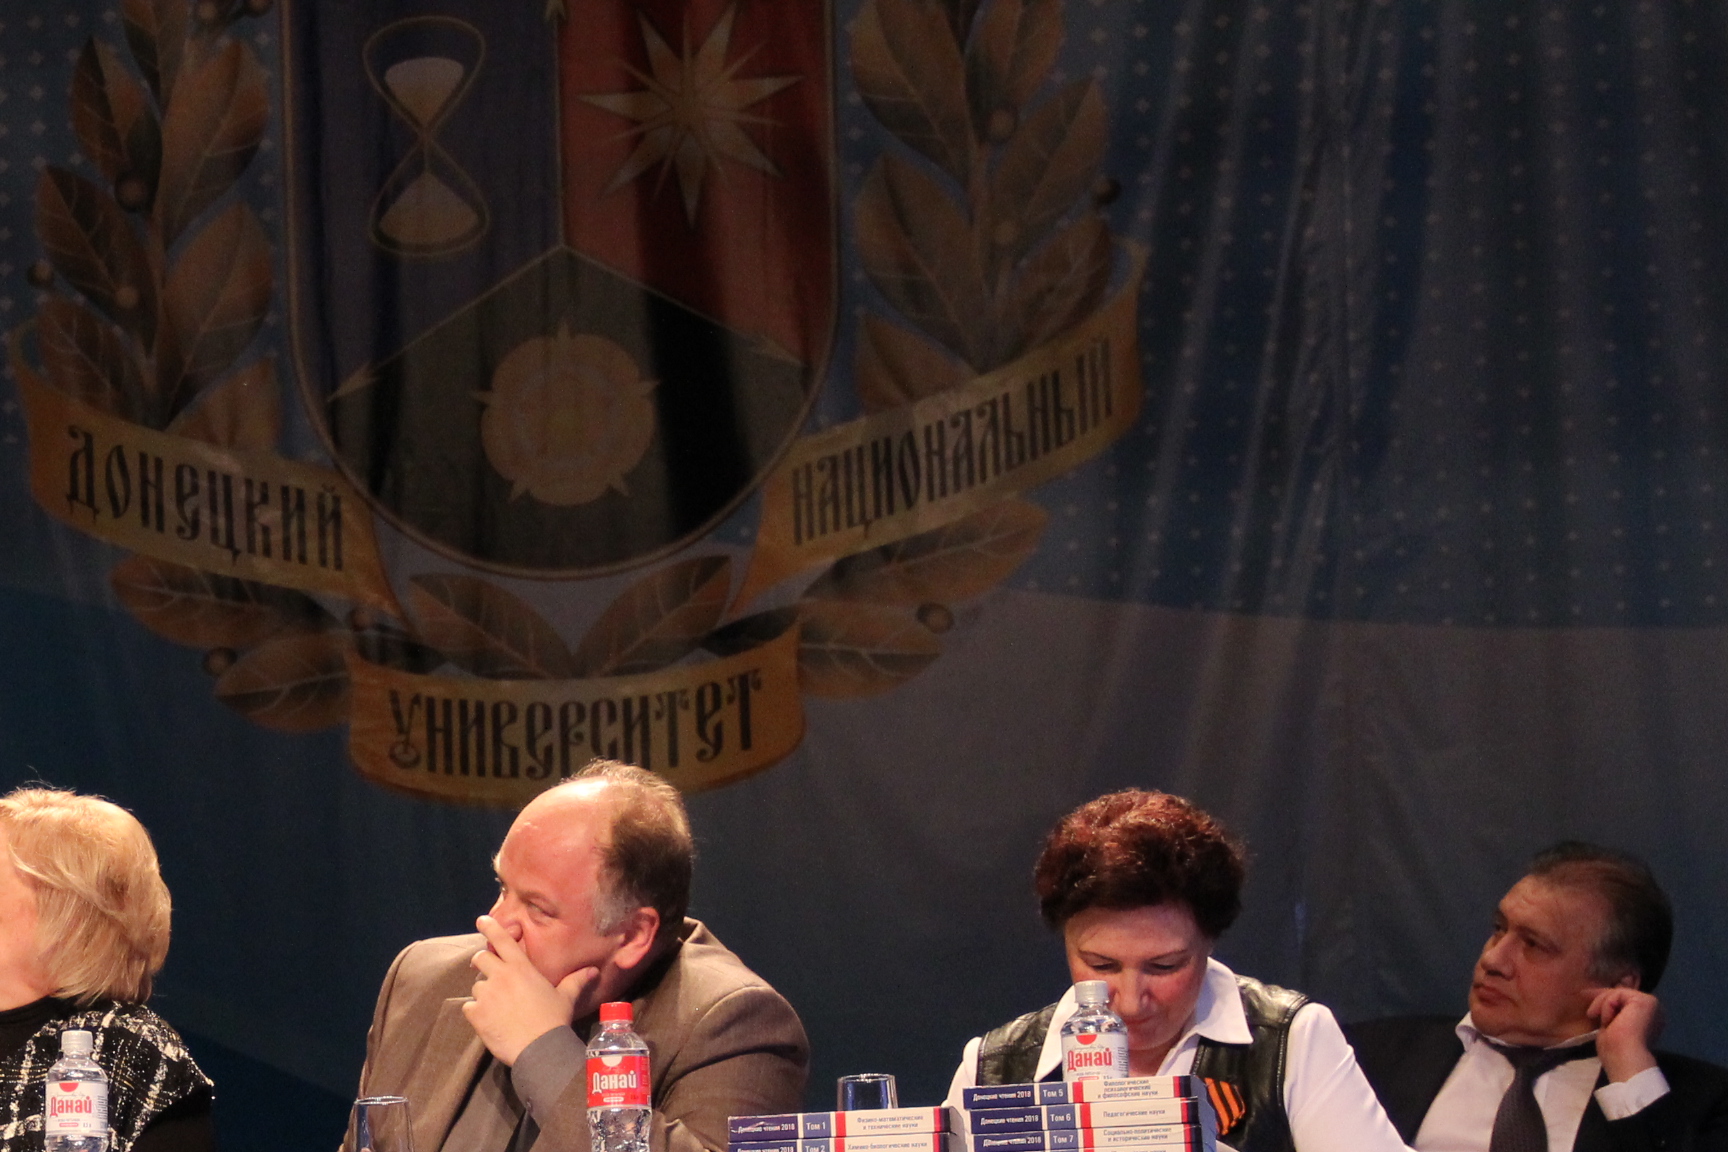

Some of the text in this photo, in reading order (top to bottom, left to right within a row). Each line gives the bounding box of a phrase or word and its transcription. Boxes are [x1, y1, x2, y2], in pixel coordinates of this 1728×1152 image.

[792, 333, 1112, 546] НАЦИОНАЛЬНЫЙ
[65, 425, 343, 571] ДОНЕЦКИЙ
[389, 668, 762, 780] УНИВЕРСИТЕТ
[1067, 1047, 1113, 1071] Данай
[592, 1070, 637, 1094] Данай
[1043, 1089, 1064, 1098] Том 5
[49, 1096, 92, 1117] Данай
[806, 1122, 826, 1131] Том 1
[1050, 1113, 1071, 1122] Том 6
[820, 1145, 826, 1152] 2
[1053, 1134, 1074, 1144] Том 7
